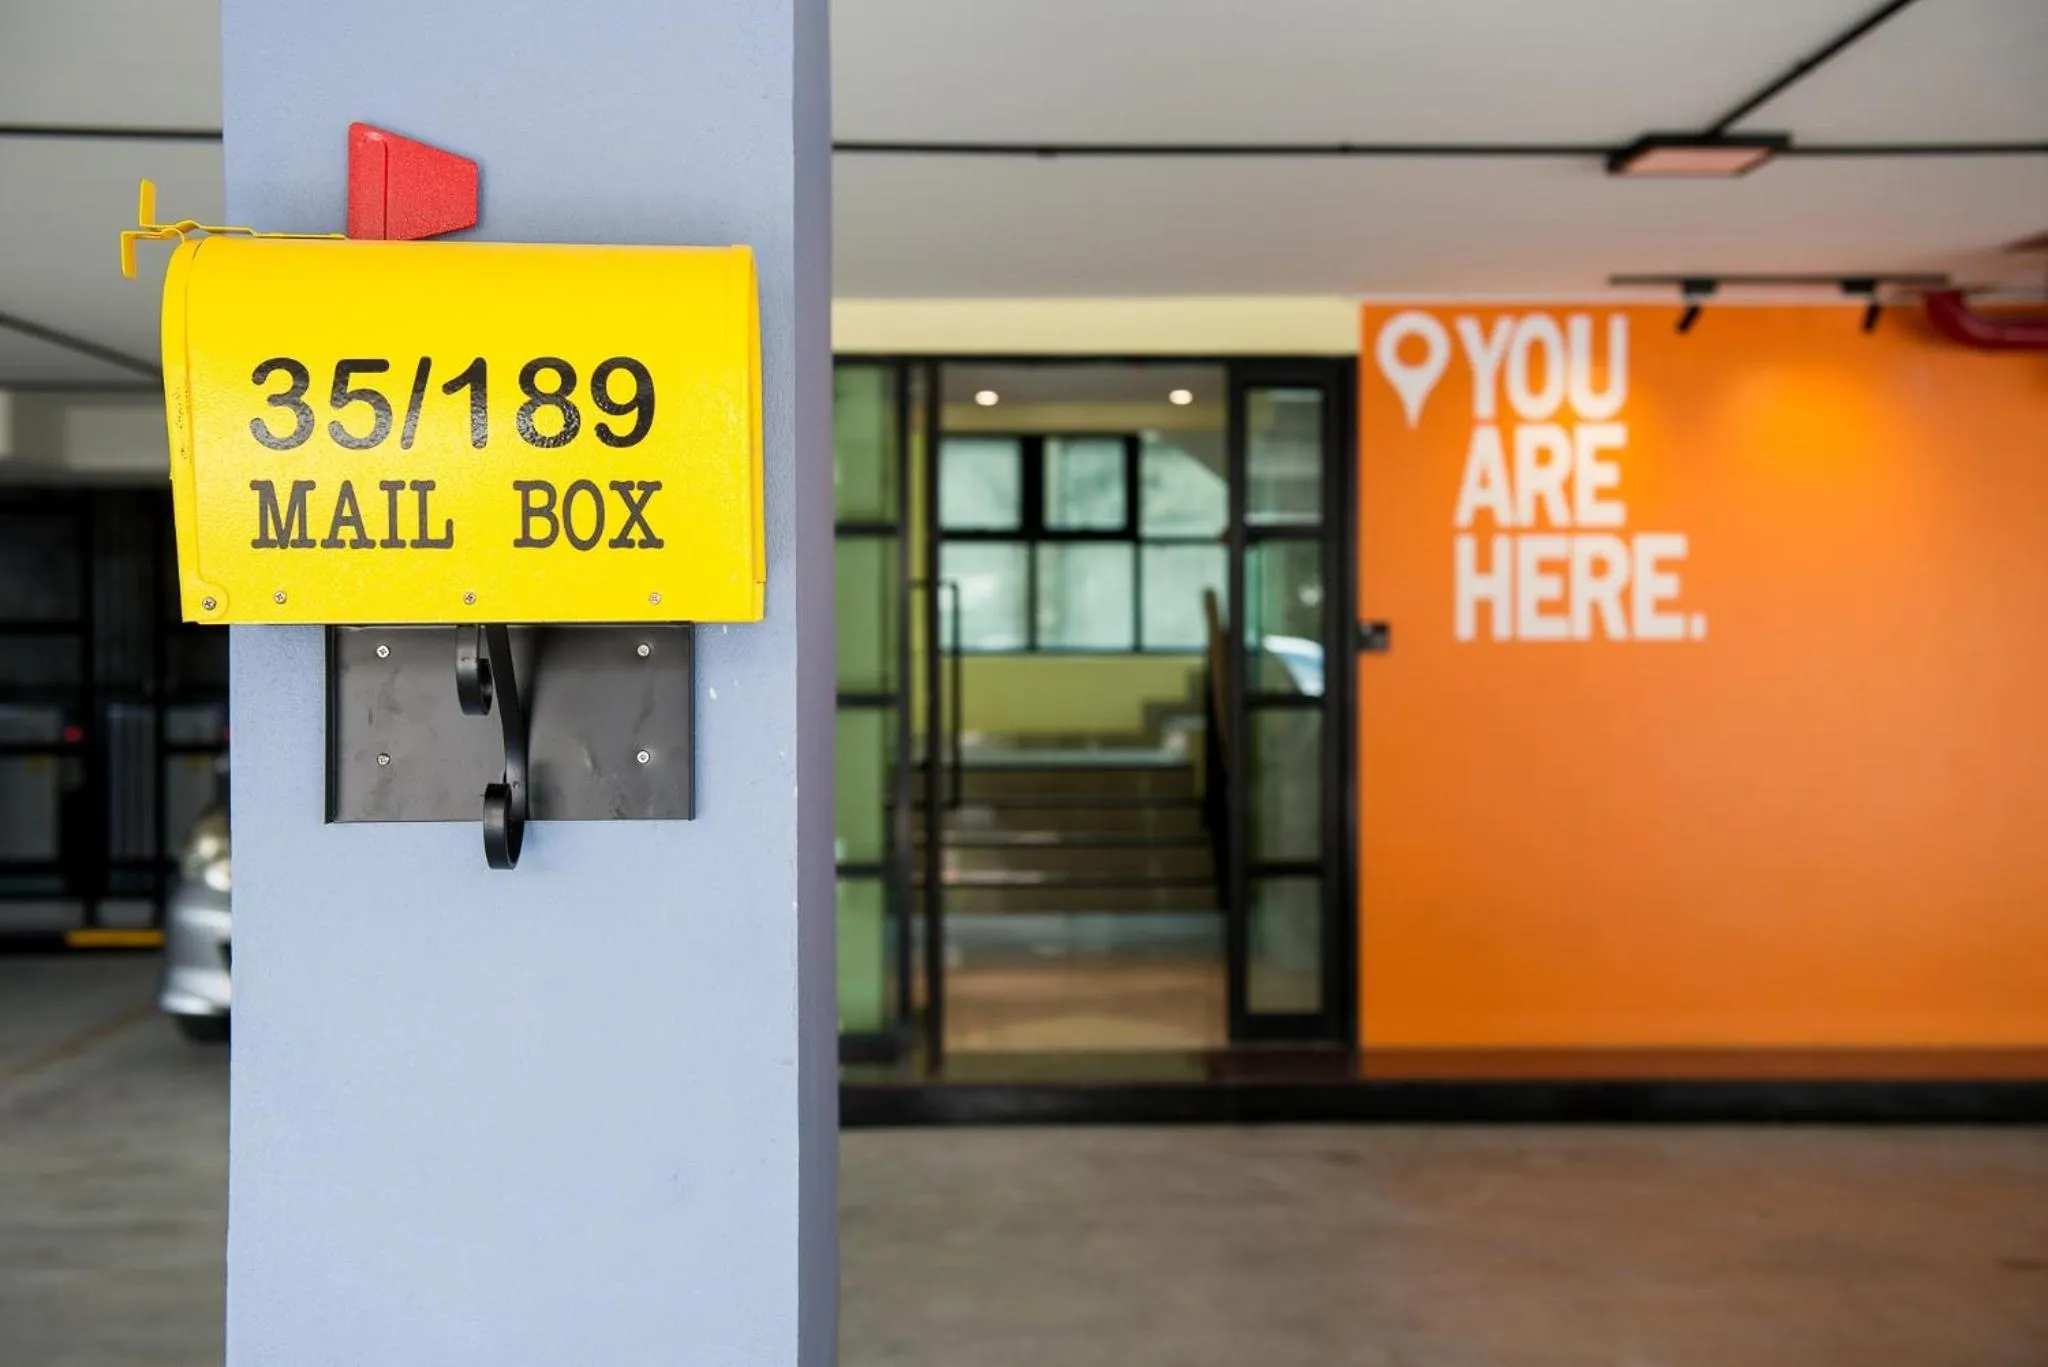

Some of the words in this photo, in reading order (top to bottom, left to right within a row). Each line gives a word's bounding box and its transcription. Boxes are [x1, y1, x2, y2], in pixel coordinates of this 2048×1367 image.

[250, 356, 655, 449] 35/189
[1456, 313, 1629, 421] YOU
[250, 480, 454, 550] MAIL
[513, 479, 664, 550] BOX
[1455, 423, 1628, 528] ARE
[1455, 534, 1707, 641] HERE.
